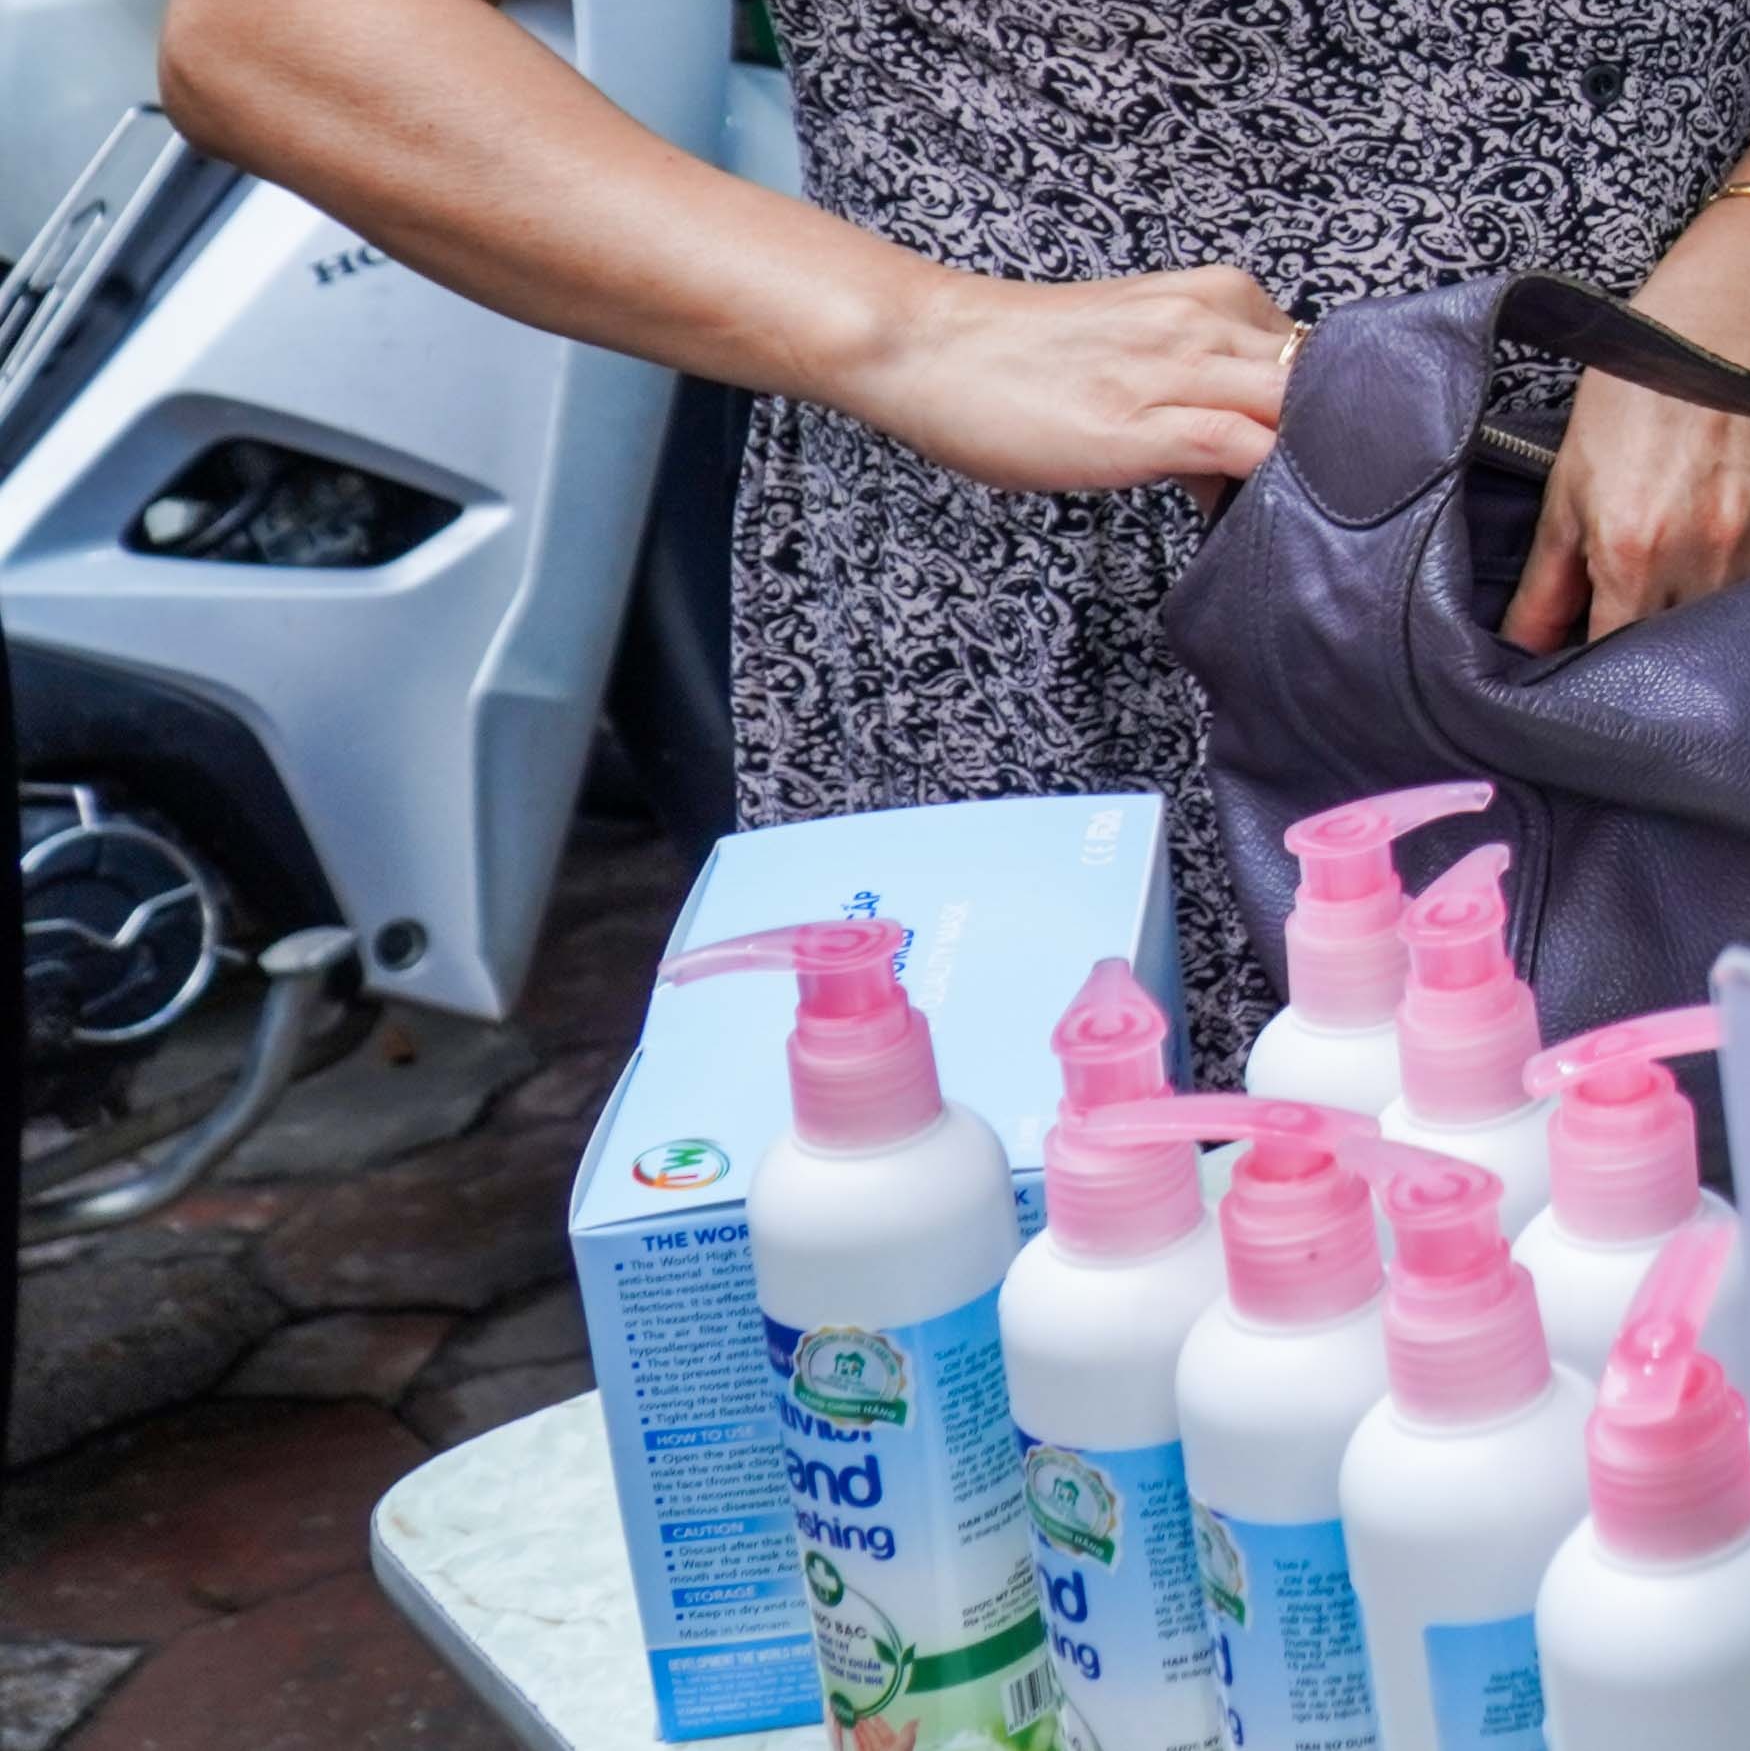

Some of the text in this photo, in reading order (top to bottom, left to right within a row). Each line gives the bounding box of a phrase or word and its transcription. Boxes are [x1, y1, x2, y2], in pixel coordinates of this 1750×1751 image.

[642, 1231, 687, 1252] THE
[660, 1255, 700, 1268] World
[656, 1432, 696, 1446] HOW
[700, 1429, 722, 1442] TO
[672, 1521, 745, 1538] CAUTION
[684, 1586, 755, 1603] STORAGE
[679, 1625, 713, 1639] Made
